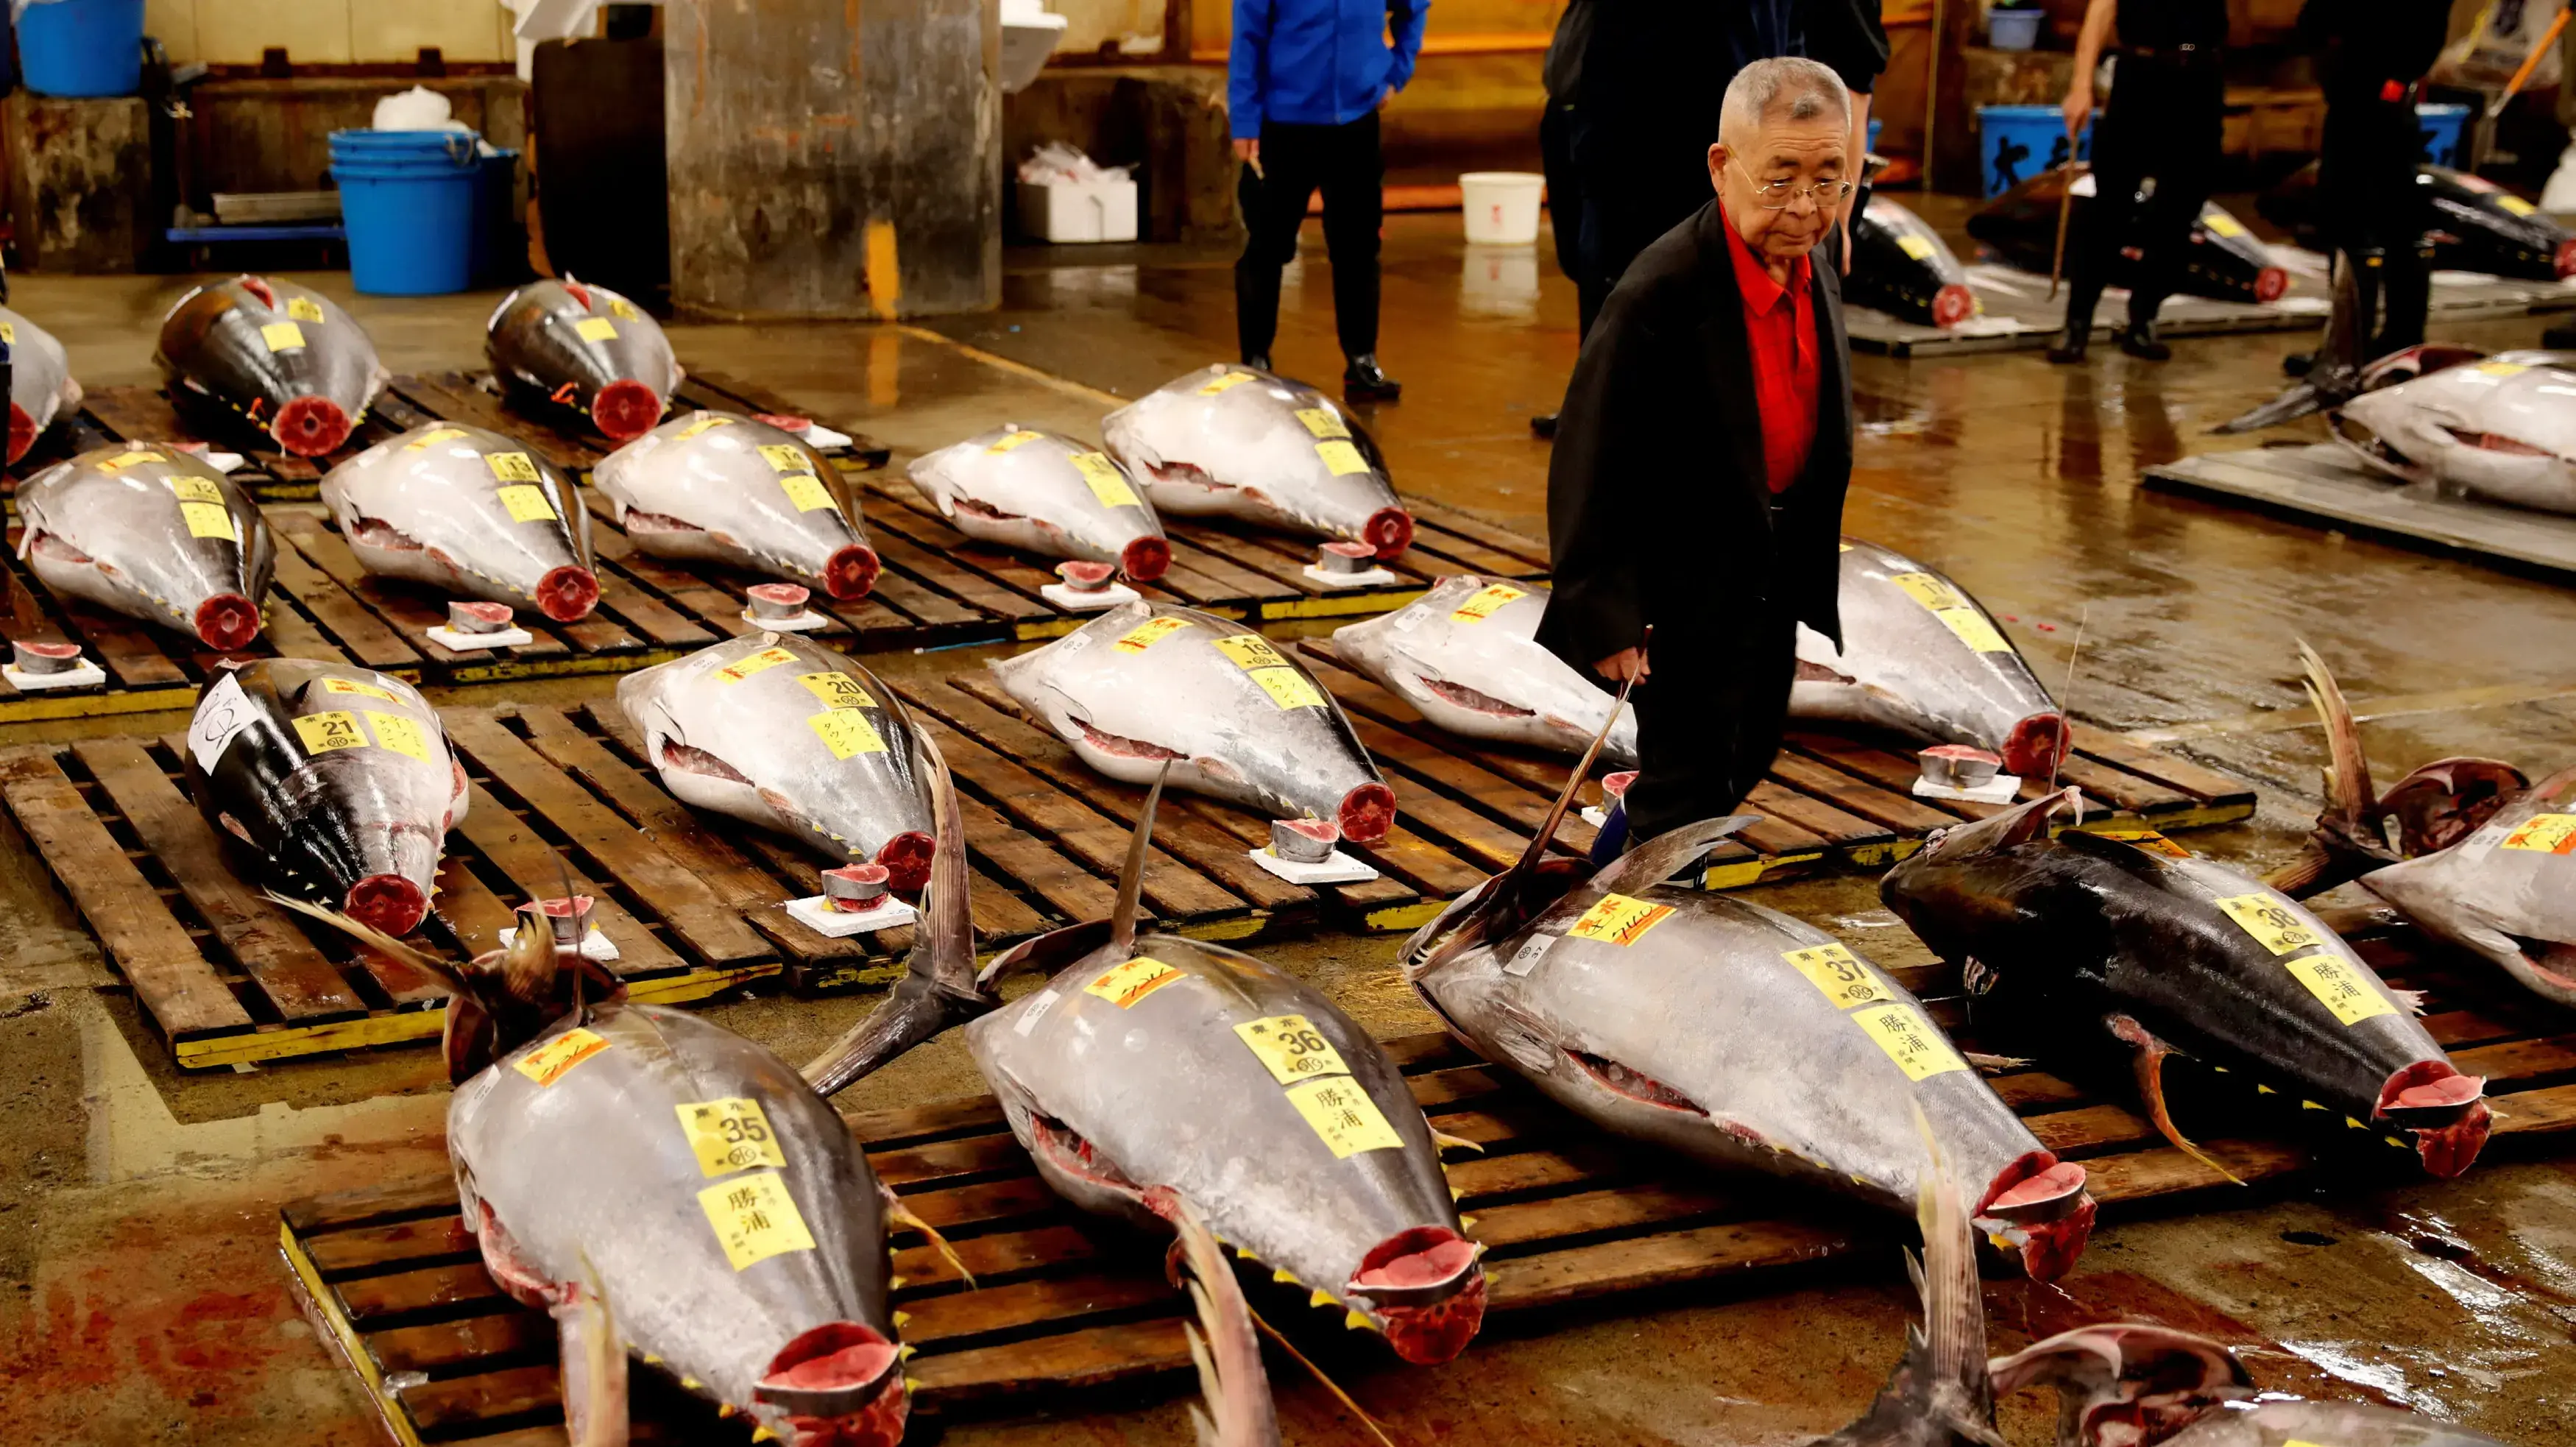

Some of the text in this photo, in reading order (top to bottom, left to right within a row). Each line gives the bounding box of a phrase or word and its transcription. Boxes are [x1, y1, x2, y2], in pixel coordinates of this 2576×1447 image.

[506, 461, 533, 473] 13
[1242, 643, 1273, 656] 19
[827, 681, 861, 695] 20
[322, 720, 355, 736] 21
[2256, 907, 2301, 929] 38
[1825, 959, 1866, 982] 37
[2313, 963, 2362, 1000] 勝浦
[1278, 1029, 1326, 1055] 36
[1879, 1013, 1929, 1053] 勝浦
[1316, 1088, 1364, 1130] 勝浦
[719, 1117, 768, 1144] 35
[727, 1186, 771, 1235] 勝浦
